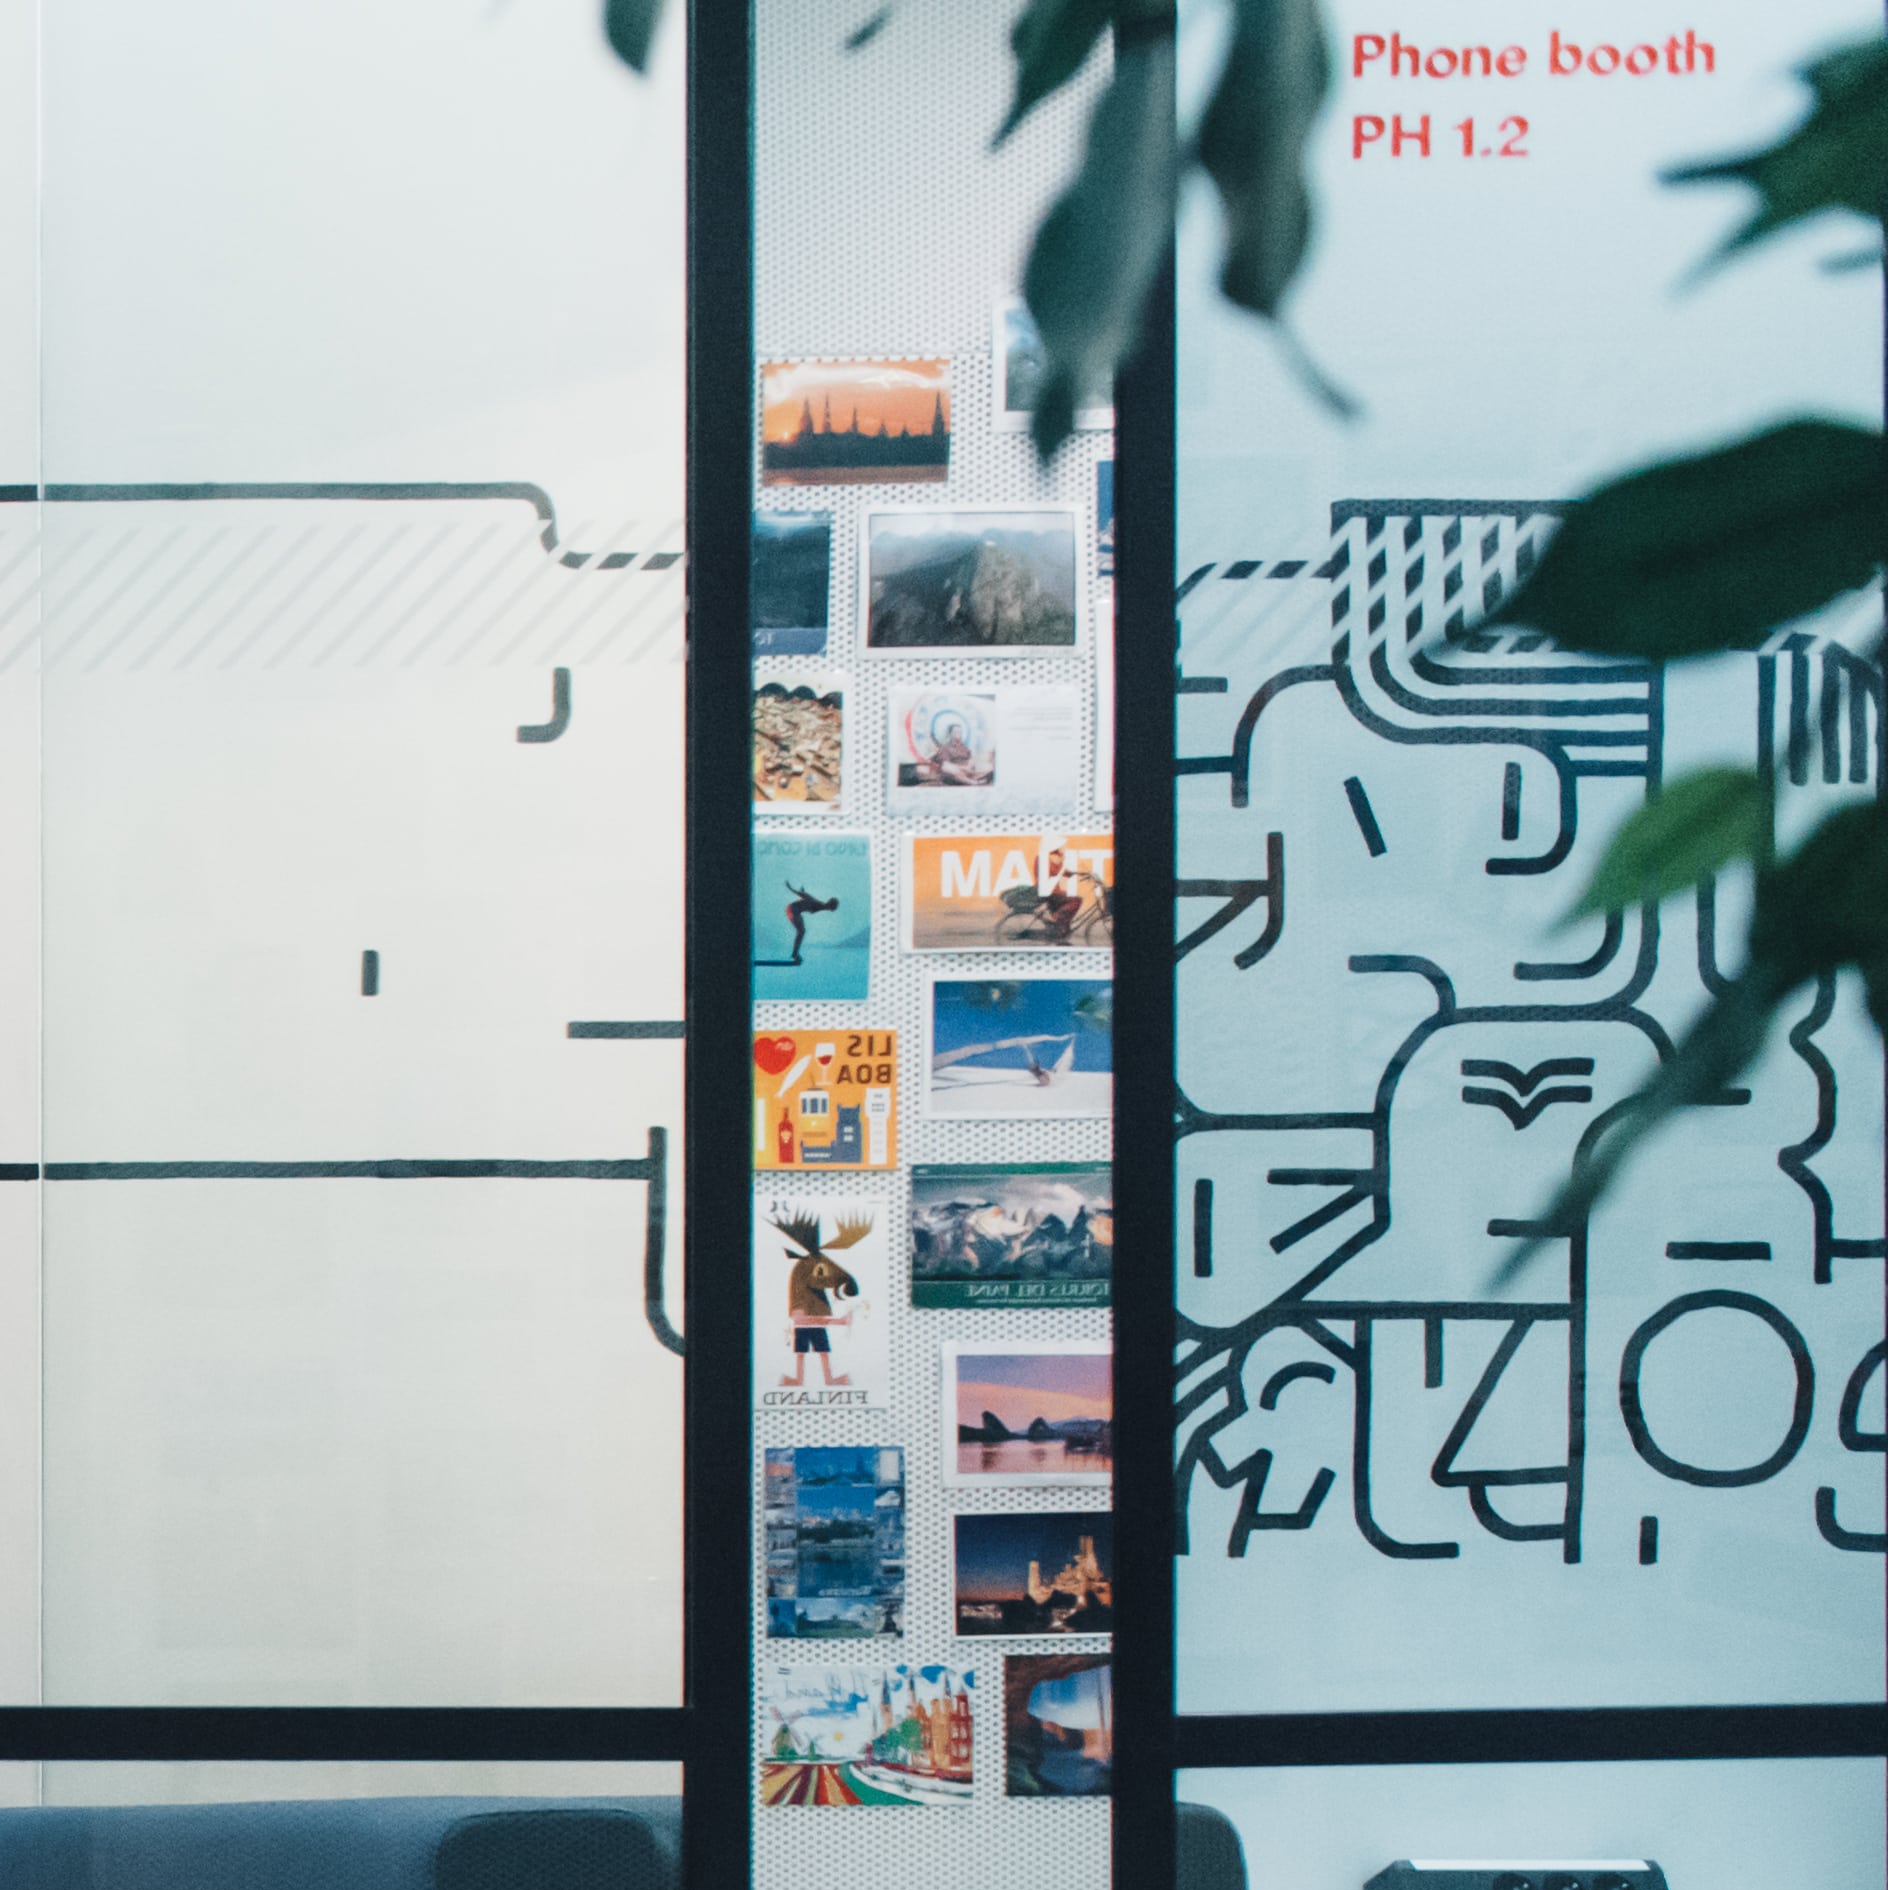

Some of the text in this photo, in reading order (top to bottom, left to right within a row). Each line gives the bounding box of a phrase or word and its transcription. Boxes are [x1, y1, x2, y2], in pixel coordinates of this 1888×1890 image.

[1352, 29, 1717, 79] Phone booth
[1352, 114, 1530, 159] PH 1.2
